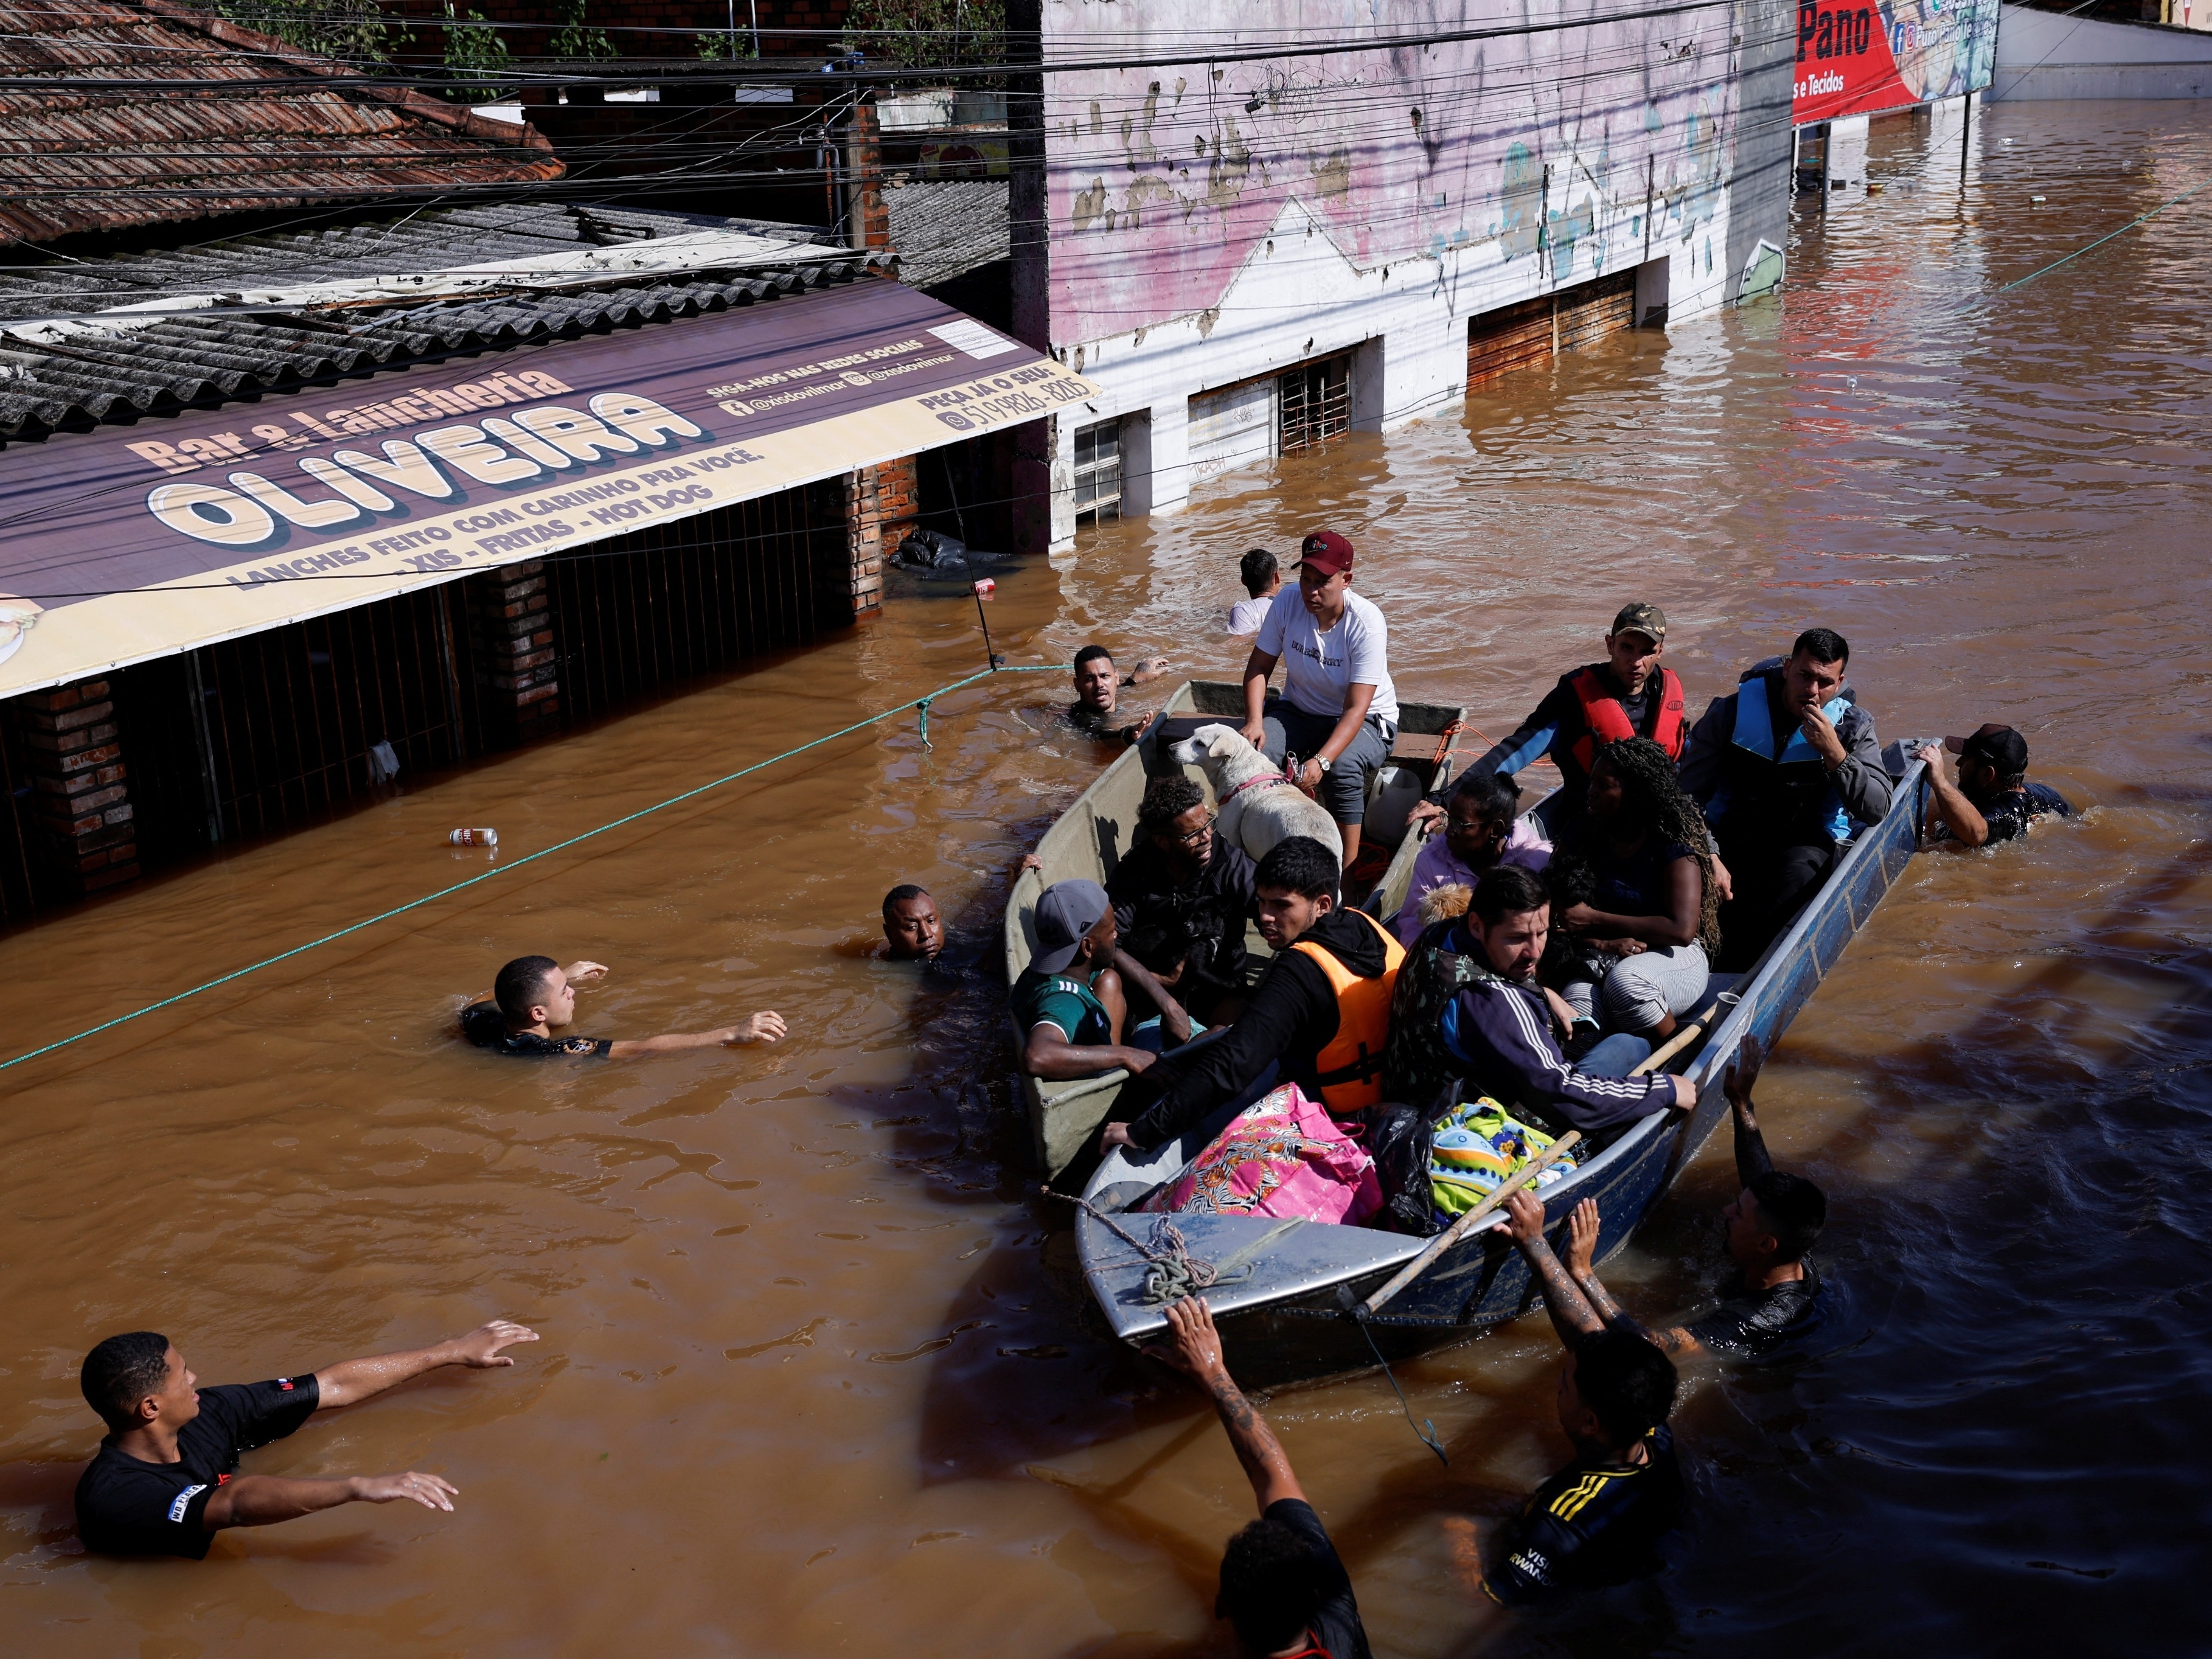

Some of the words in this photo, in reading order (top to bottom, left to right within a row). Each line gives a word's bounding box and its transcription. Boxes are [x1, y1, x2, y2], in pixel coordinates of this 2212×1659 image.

[1796, 0, 1870, 63] Pano
[1915, 24, 1938, 49] Puro
[1939, 21, 1961, 46] Pano
[1963, 17, 1994, 41] Tecidos
[1800, 81, 1807, 98] e
[1808, 69, 1844, 96] Tecidos
[706, 373, 788, 398] SIGA-NOS
[784, 364, 823, 379] NAS
[817, 353, 869, 371] REDES
[864, 339, 924, 360] SOCIAIS
[750, 380, 847, 411] @xisdovilmar
[866, 353, 955, 381] @xisdovilmar
[916, 389, 974, 411] PEÇA
[992, 378, 1014, 389] O
[1009, 366, 1056, 384] SEU:
[124, 431, 261, 475] Bar
[251, 424, 321, 452] &
[287, 369, 576, 442] Lancheria
[961, 405, 998, 425] 51
[1039, 377, 1091, 402] 8205
[146, 392, 704, 546] OLIVEIRA
[225, 546, 371, 591] LANCHES
[366, 526, 453, 556] FEITO
[453, 508, 526, 533] COM
[520, 479, 641, 516] CARINHO
[637, 465, 698, 487] PRA
[687, 447, 765, 473] VOCÊ.
[401, 549, 462, 575] XIS
[473, 519, 576, 555] FRITAS
[587, 498, 653, 525] HOT
[644, 484, 714, 510] DOG
[172, 1506, 182, 1520] WD
[1509, 1553, 1553, 1586] RWAND
